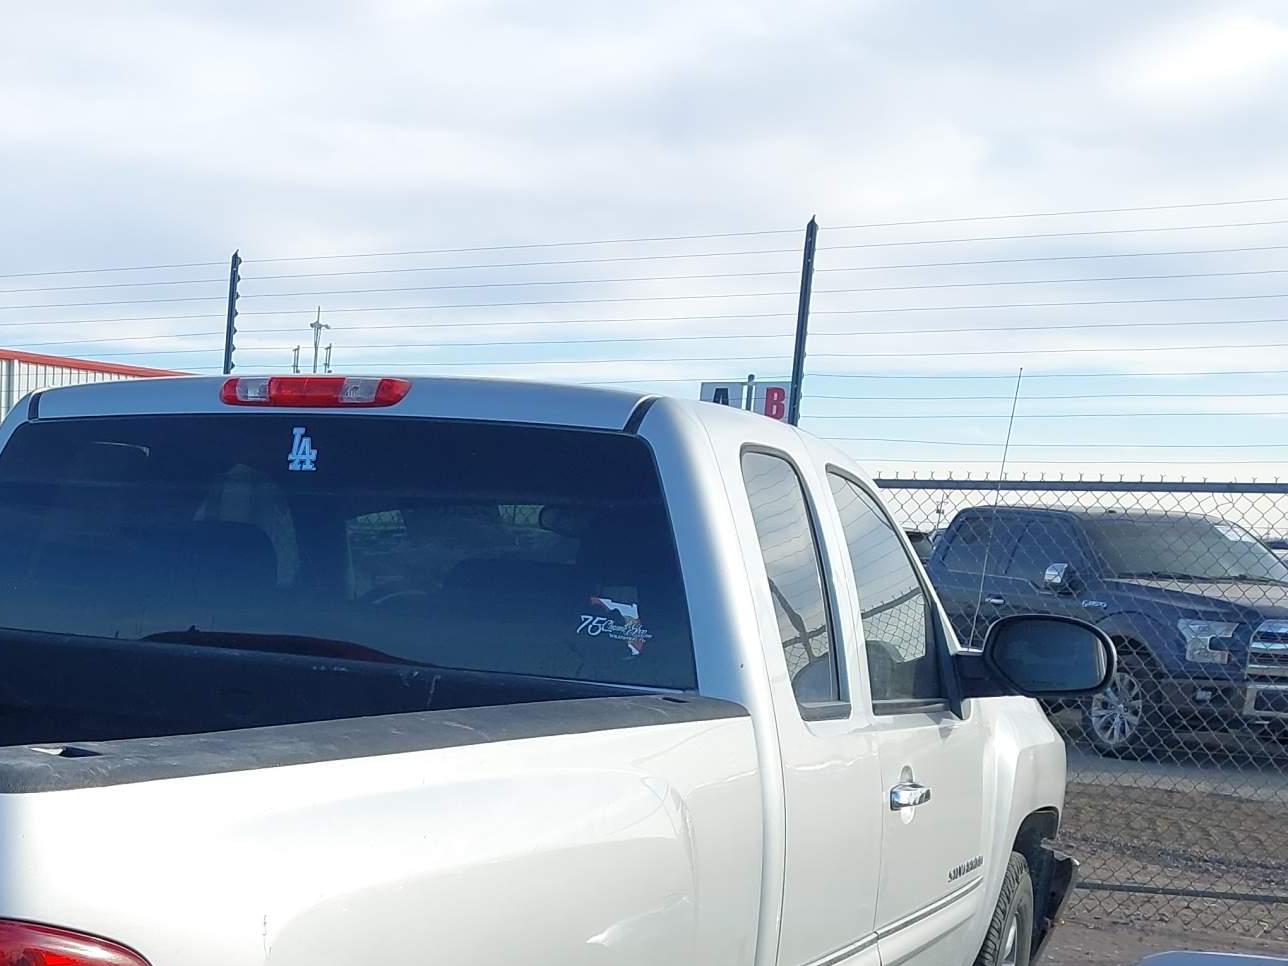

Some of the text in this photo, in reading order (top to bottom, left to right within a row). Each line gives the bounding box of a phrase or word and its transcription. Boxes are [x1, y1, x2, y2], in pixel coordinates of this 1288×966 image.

[764, 387, 786, 420] B
[288, 427, 317, 470] LA
[576, 615, 607, 635] 75
